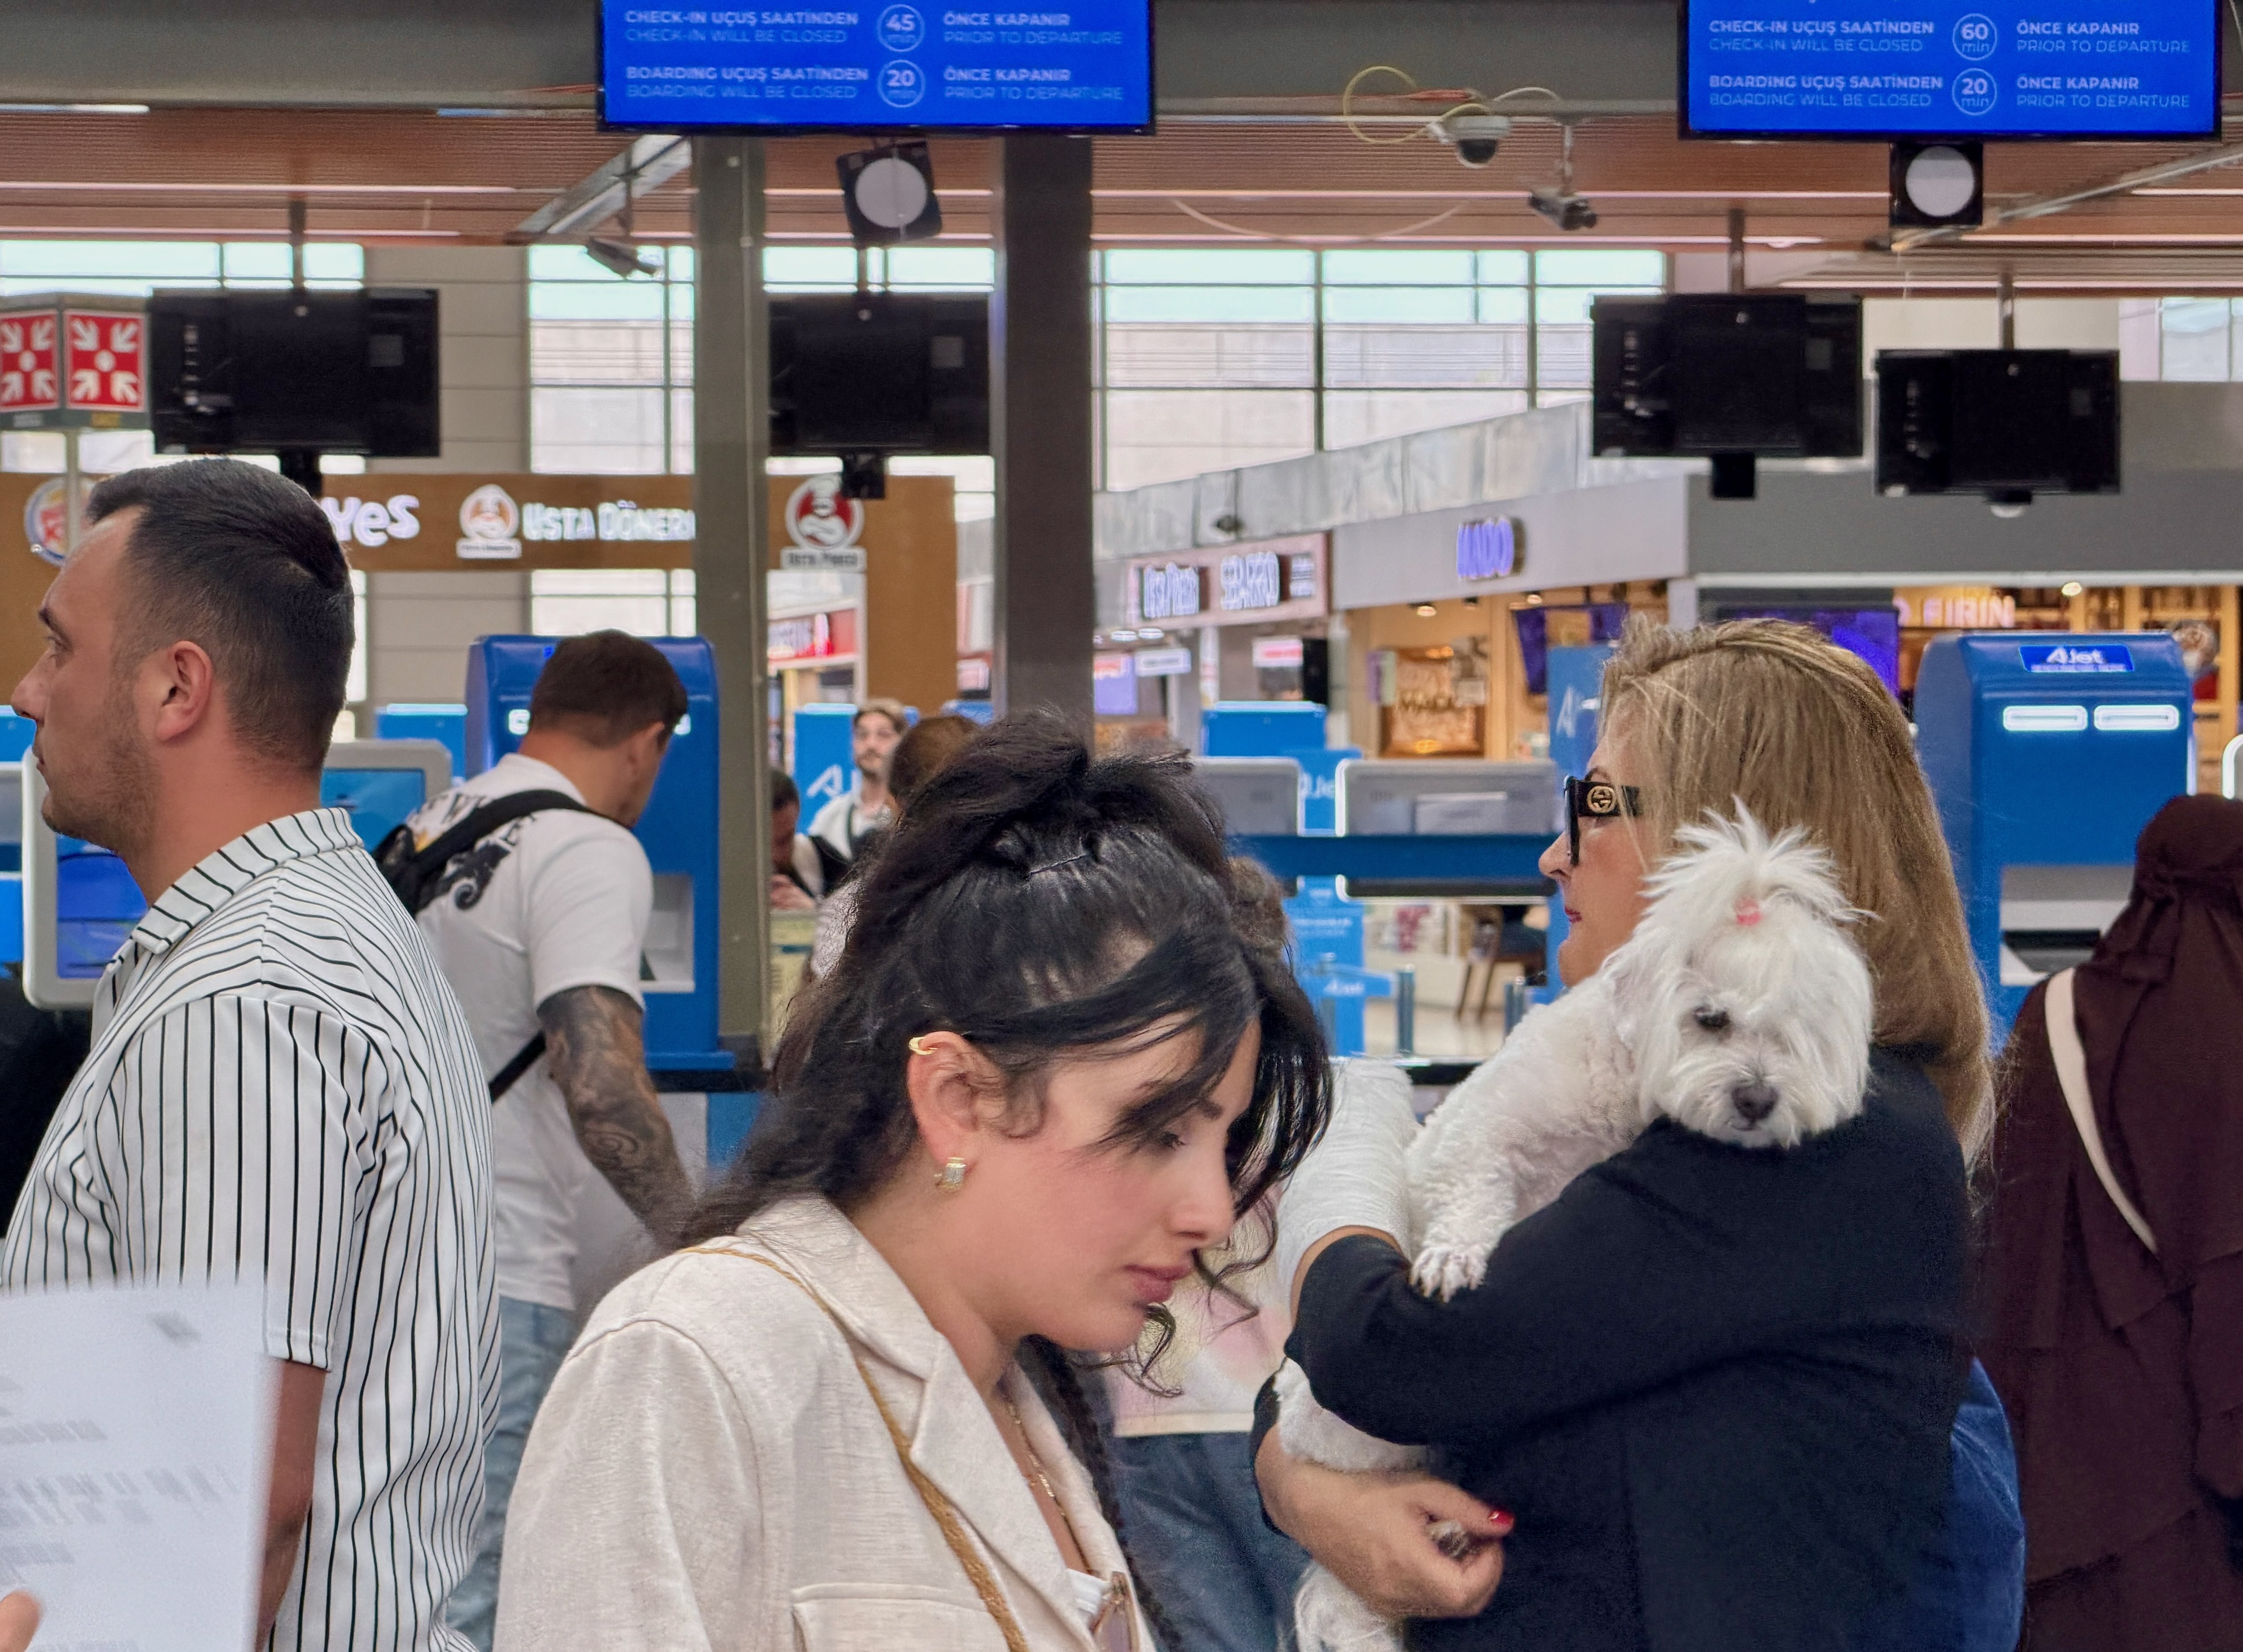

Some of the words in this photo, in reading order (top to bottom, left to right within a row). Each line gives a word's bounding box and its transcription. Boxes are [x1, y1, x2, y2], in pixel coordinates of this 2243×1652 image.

[625, 10, 707, 23] CHECK-IN
[711, 11, 757, 27] UÇUŞ
[886, 14, 916, 31] 45
[943, 10, 990, 25] ÖNCE
[1709, 20, 1787, 33] CHECK-IN
[1792, 21, 1836, 36] UÇUŞ
[1840, 19, 1935, 34] SAATİNDEN
[1961, 23, 1988, 40] 60
[2017, 19, 2063, 35] ÖNCE
[2067, 22, 2140, 35] KAPANIR
[780, 29, 847, 43] CLOSED
[944, 31, 995, 43] PRIOR
[1000, 31, 1021, 43] TO
[1025, 31, 1123, 44] DEPARTURE
[1709, 38, 1787, 51] CHECK-IN
[1791, 39, 1828, 51] WILL
[1834, 39, 1855, 52] BE
[1858, 39, 1923, 52] CLOSED
[1961, 41, 1990, 52] min
[2017, 39, 2066, 52] PRIOR
[2071, 40, 2091, 52] TO
[2096, 40, 2191, 53] DEPARTURE
[626, 66, 718, 79] BOARDING
[721, 67, 767, 82] UÇUŞ
[887, 70, 916, 87] 20
[944, 66, 990, 81] ÖNCE
[995, 69, 1071, 81] KAPANIR
[1709, 75, 1797, 88] BOARDING
[1801, 76, 1845, 92] UÇUŞ
[1850, 73, 1943, 89] SAATİNDEN
[1961, 78, 1988, 95] 20
[2017, 74, 2062, 89] ÖNCE
[2066, 77, 2139, 89] KAPANIR
[626, 85, 715, 97] BOARDING
[792, 85, 857, 98] CLOSED
[945, 87, 995, 99] PRIOR
[1001, 87, 1022, 100] TO
[1026, 87, 1123, 100] DEPARTURE
[1709, 93, 1795, 106] BOARDING
[1799, 94, 1838, 106] WILL
[1843, 94, 1863, 106] BE
[1868, 93, 1932, 107] CLOSED
[1961, 95, 1990, 108] min
[2017, 94, 2066, 107] PRIOR
[2072, 95, 2091, 107] TO
[2095, 94, 2190, 108] DEPARTURE
